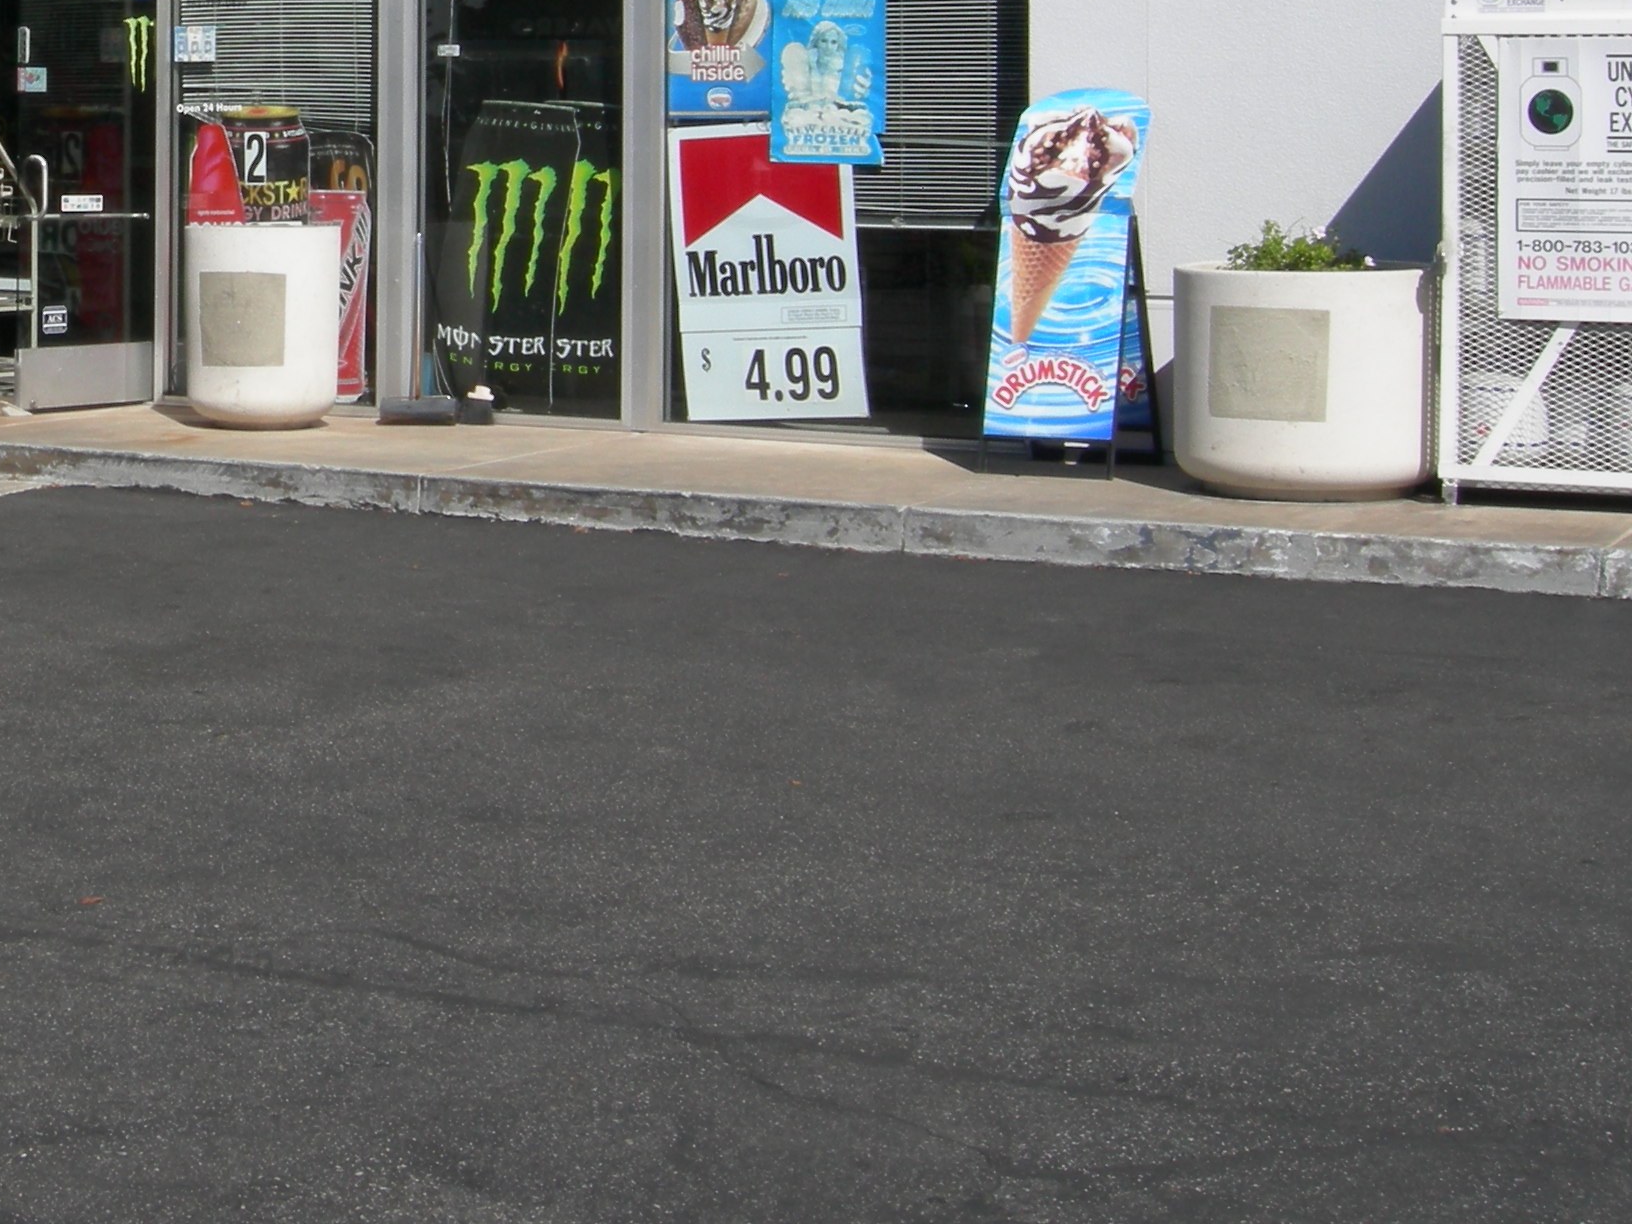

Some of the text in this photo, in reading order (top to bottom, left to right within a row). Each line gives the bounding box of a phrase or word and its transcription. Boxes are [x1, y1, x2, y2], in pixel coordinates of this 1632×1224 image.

[691, 46, 741, 66] chillin
[691, 64, 745, 82] inside
[176, 103, 243, 114] Open 24 Hours
[793, 134, 861, 145] FROZEN
[246, 134, 265, 183] 2
[1517, 239, 1632, 254] 1-800-783-10
[686, 234, 846, 297] Marlboro
[1518, 256, 1546, 271] NO
[1518, 275, 1611, 291] FLAMMABLE
[47, 314, 63, 324] ACS
[701, 346, 840, 402] $ 4.99
[994, 358, 1108, 410] DRUMSTICK
